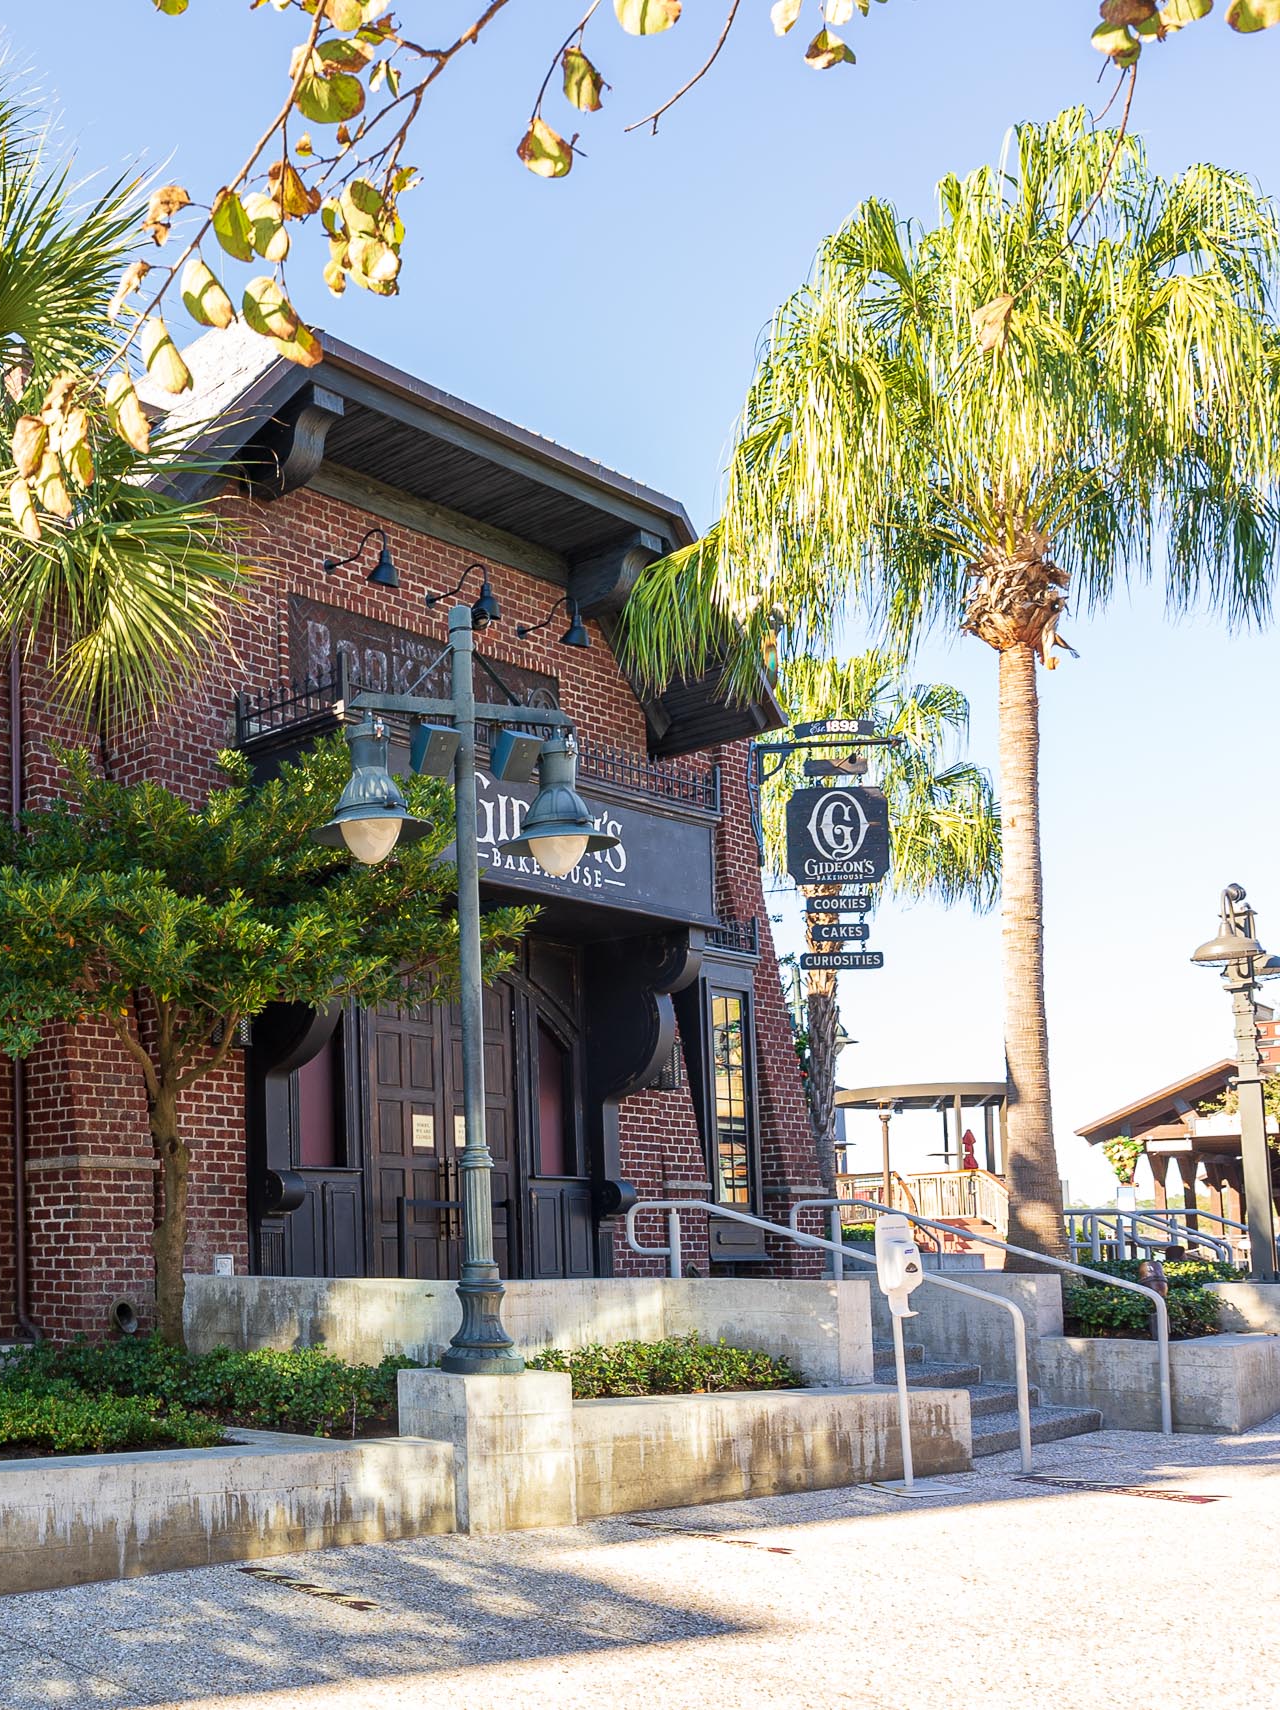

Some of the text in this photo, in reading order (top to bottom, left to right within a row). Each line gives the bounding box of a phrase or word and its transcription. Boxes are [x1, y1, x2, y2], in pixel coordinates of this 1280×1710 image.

[826, 720, 859, 733] 1898
[492, 848, 604, 888] BAKEUSE
[804, 858, 875, 876] GIDEON'S
[813, 899, 867, 910] COOKIES
[821, 926, 863, 938] CAKES
[805, 954, 881, 967] CURIOSITIES
